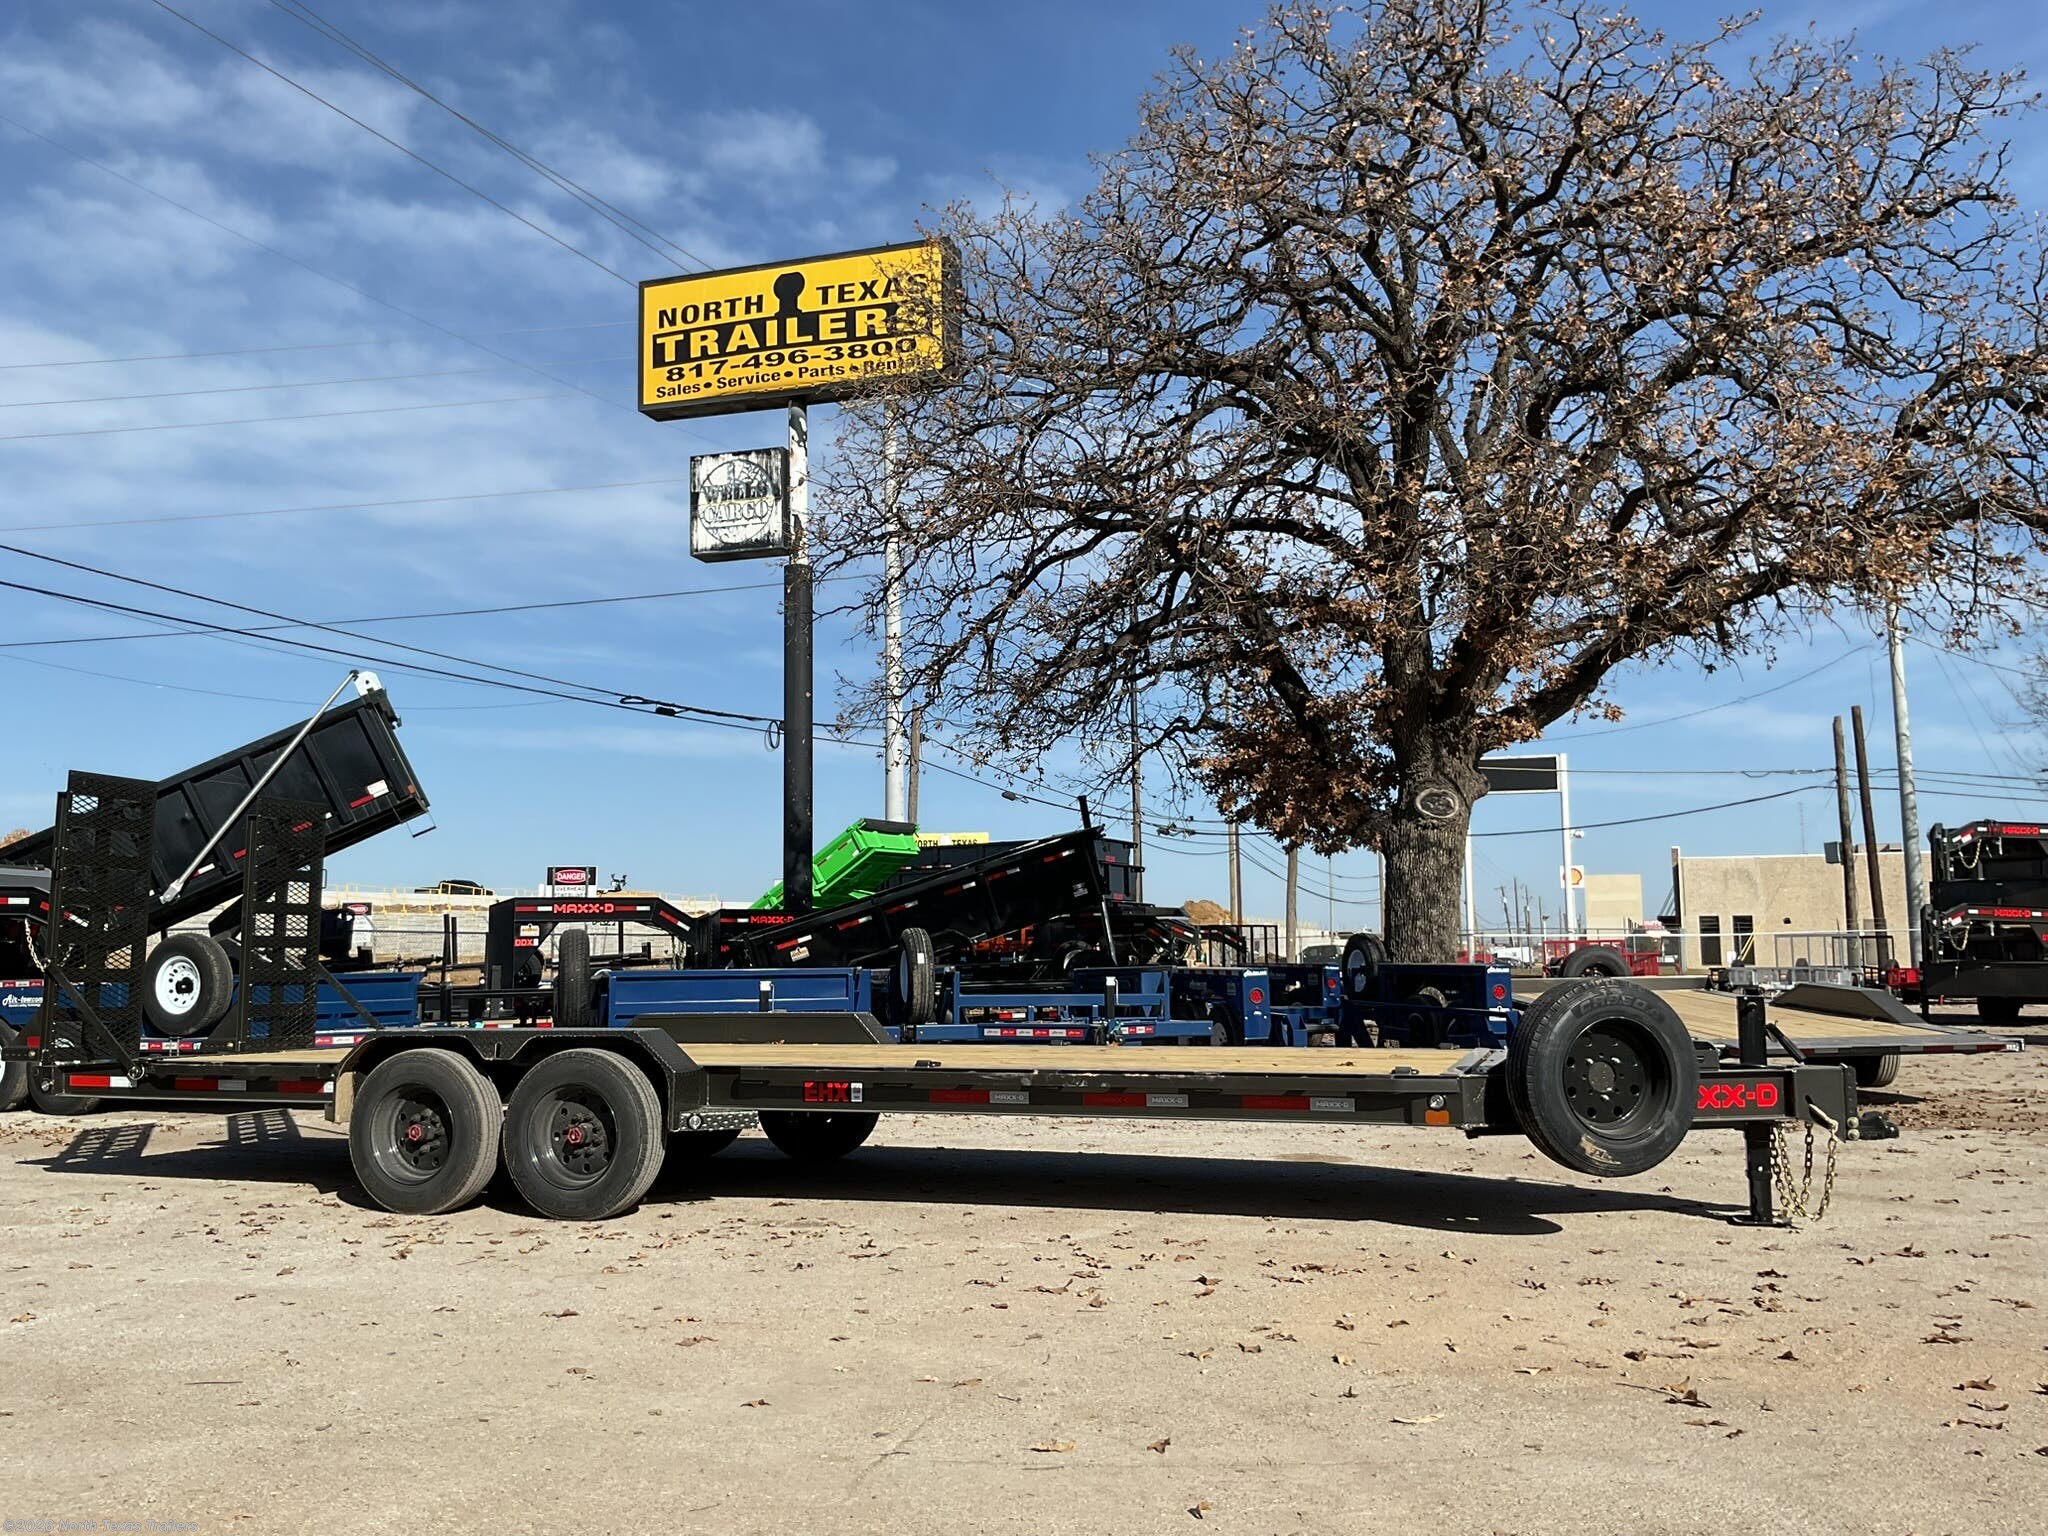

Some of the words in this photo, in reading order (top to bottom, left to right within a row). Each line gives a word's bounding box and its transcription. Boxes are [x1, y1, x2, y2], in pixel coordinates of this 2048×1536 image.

[658, 294, 764, 329] NORTH
[816, 273, 928, 306] TEXAS
[666, 337, 918, 382] 817-496-3800
[656, 383, 701, 399] Sales
[716, 371, 781, 389] Service
[798, 364, 845, 379] Parts
[703, 500, 769, 524] CARGO
[556, 872, 586, 880] DANGER
[553, 903, 614, 914] MAXX-D
[750, 915, 794, 924] MAXX-D
[804, 1082, 850, 1102] EHX
[1697, 1083, 1778, 1109] XX-D
